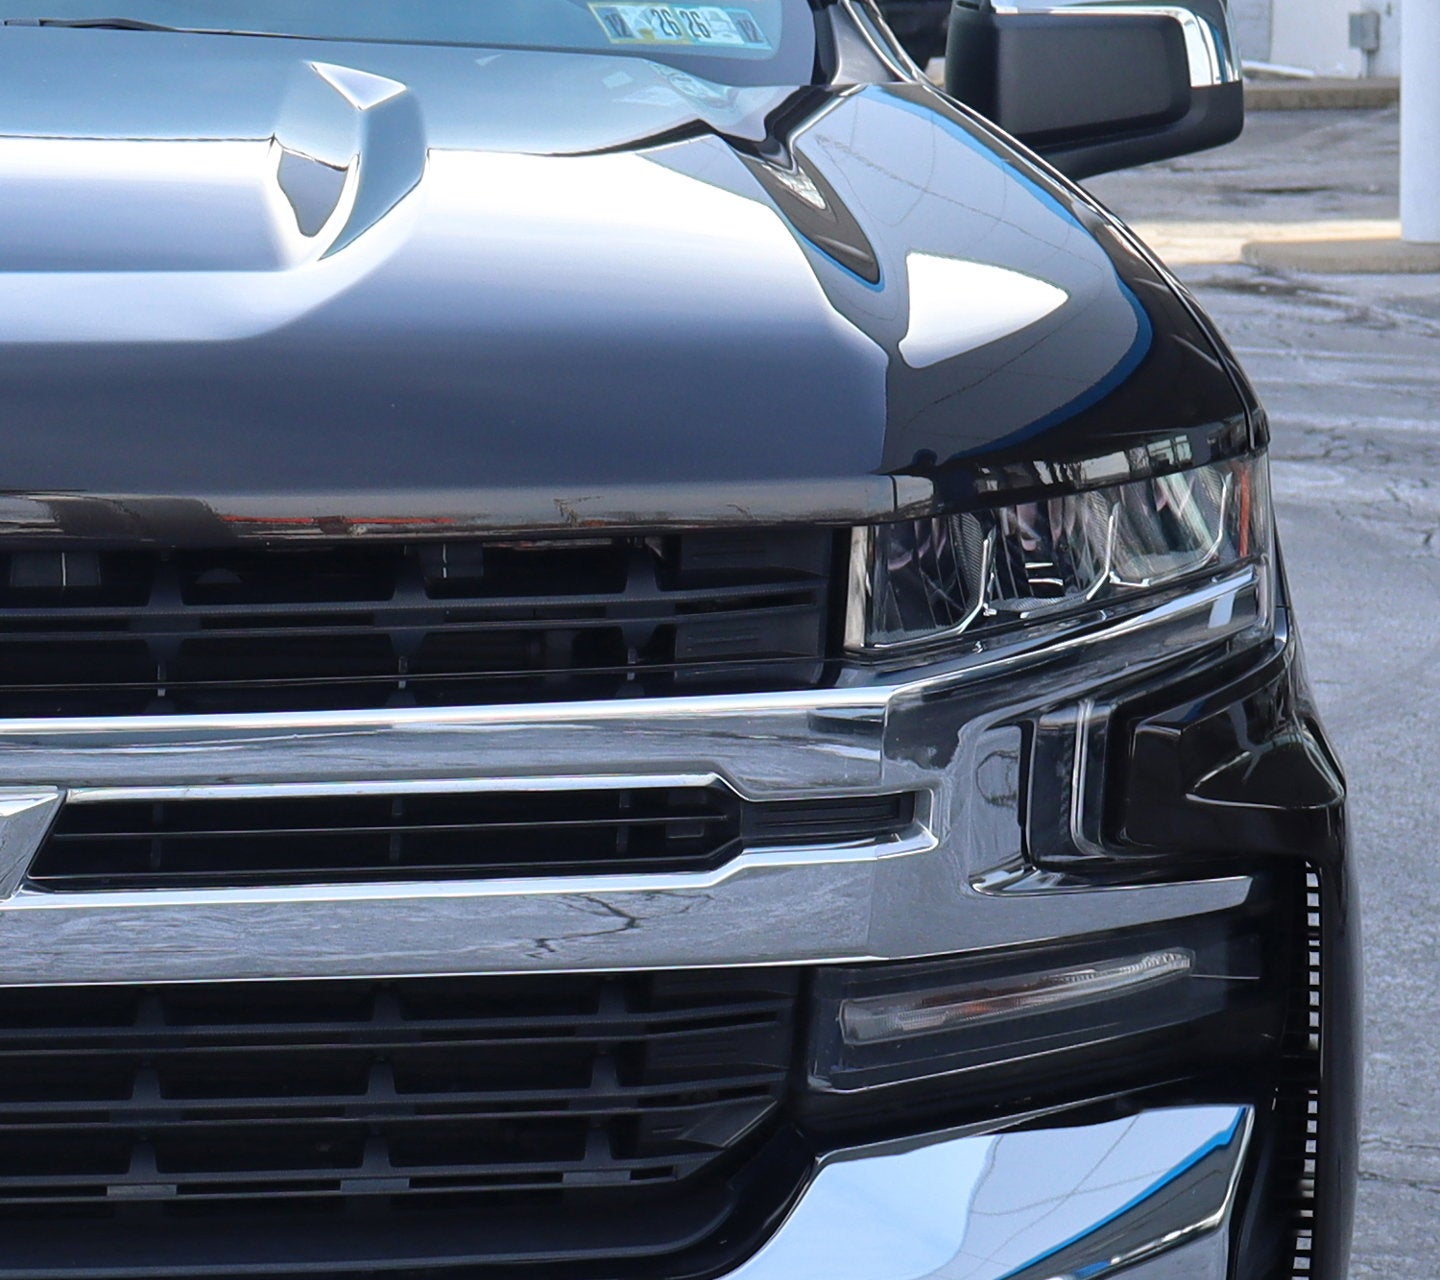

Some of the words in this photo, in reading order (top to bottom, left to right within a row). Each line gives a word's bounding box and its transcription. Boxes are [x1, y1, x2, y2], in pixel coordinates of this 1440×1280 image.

[604, 13, 633, 38] 12
[651, 9, 682, 37] 26
[680, 10, 711, 39] 26
